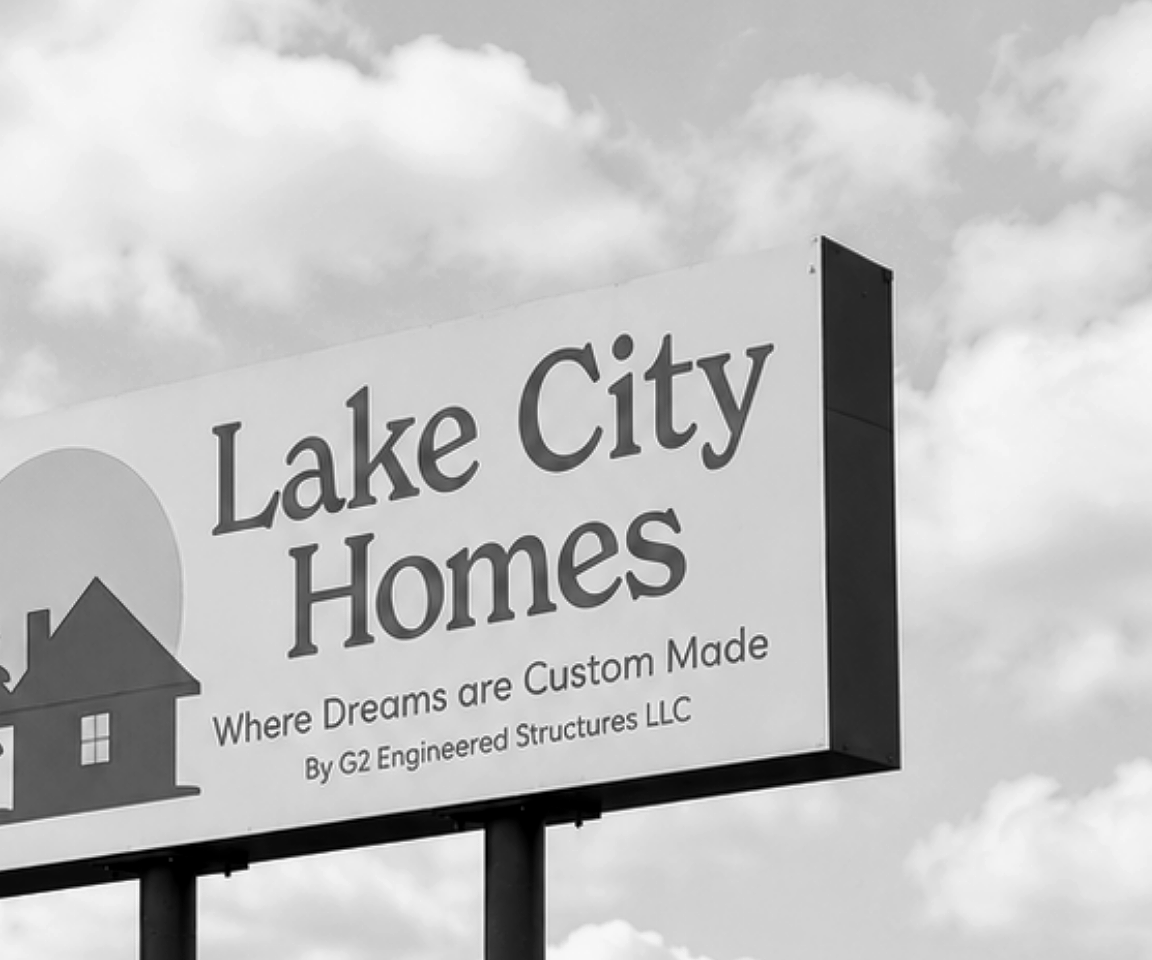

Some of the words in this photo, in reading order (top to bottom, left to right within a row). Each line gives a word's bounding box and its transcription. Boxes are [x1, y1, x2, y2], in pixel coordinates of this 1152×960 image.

[212, 386, 479, 536] Lake
[518, 334, 774, 473] City
[288, 508, 687, 659] Homes
[212, 710, 313, 747] Where
[323, 687, 448, 731] Dreams
[458, 676, 513, 708] are
[524, 653, 654, 696] Custom
[667, 626, 769, 674] Made
[305, 756, 334, 785] By
[338, 749, 371, 775] G2
[377, 726, 509, 772] Engineered
[515, 711, 638, 748] Structures
[646, 695, 692, 728] LLC
